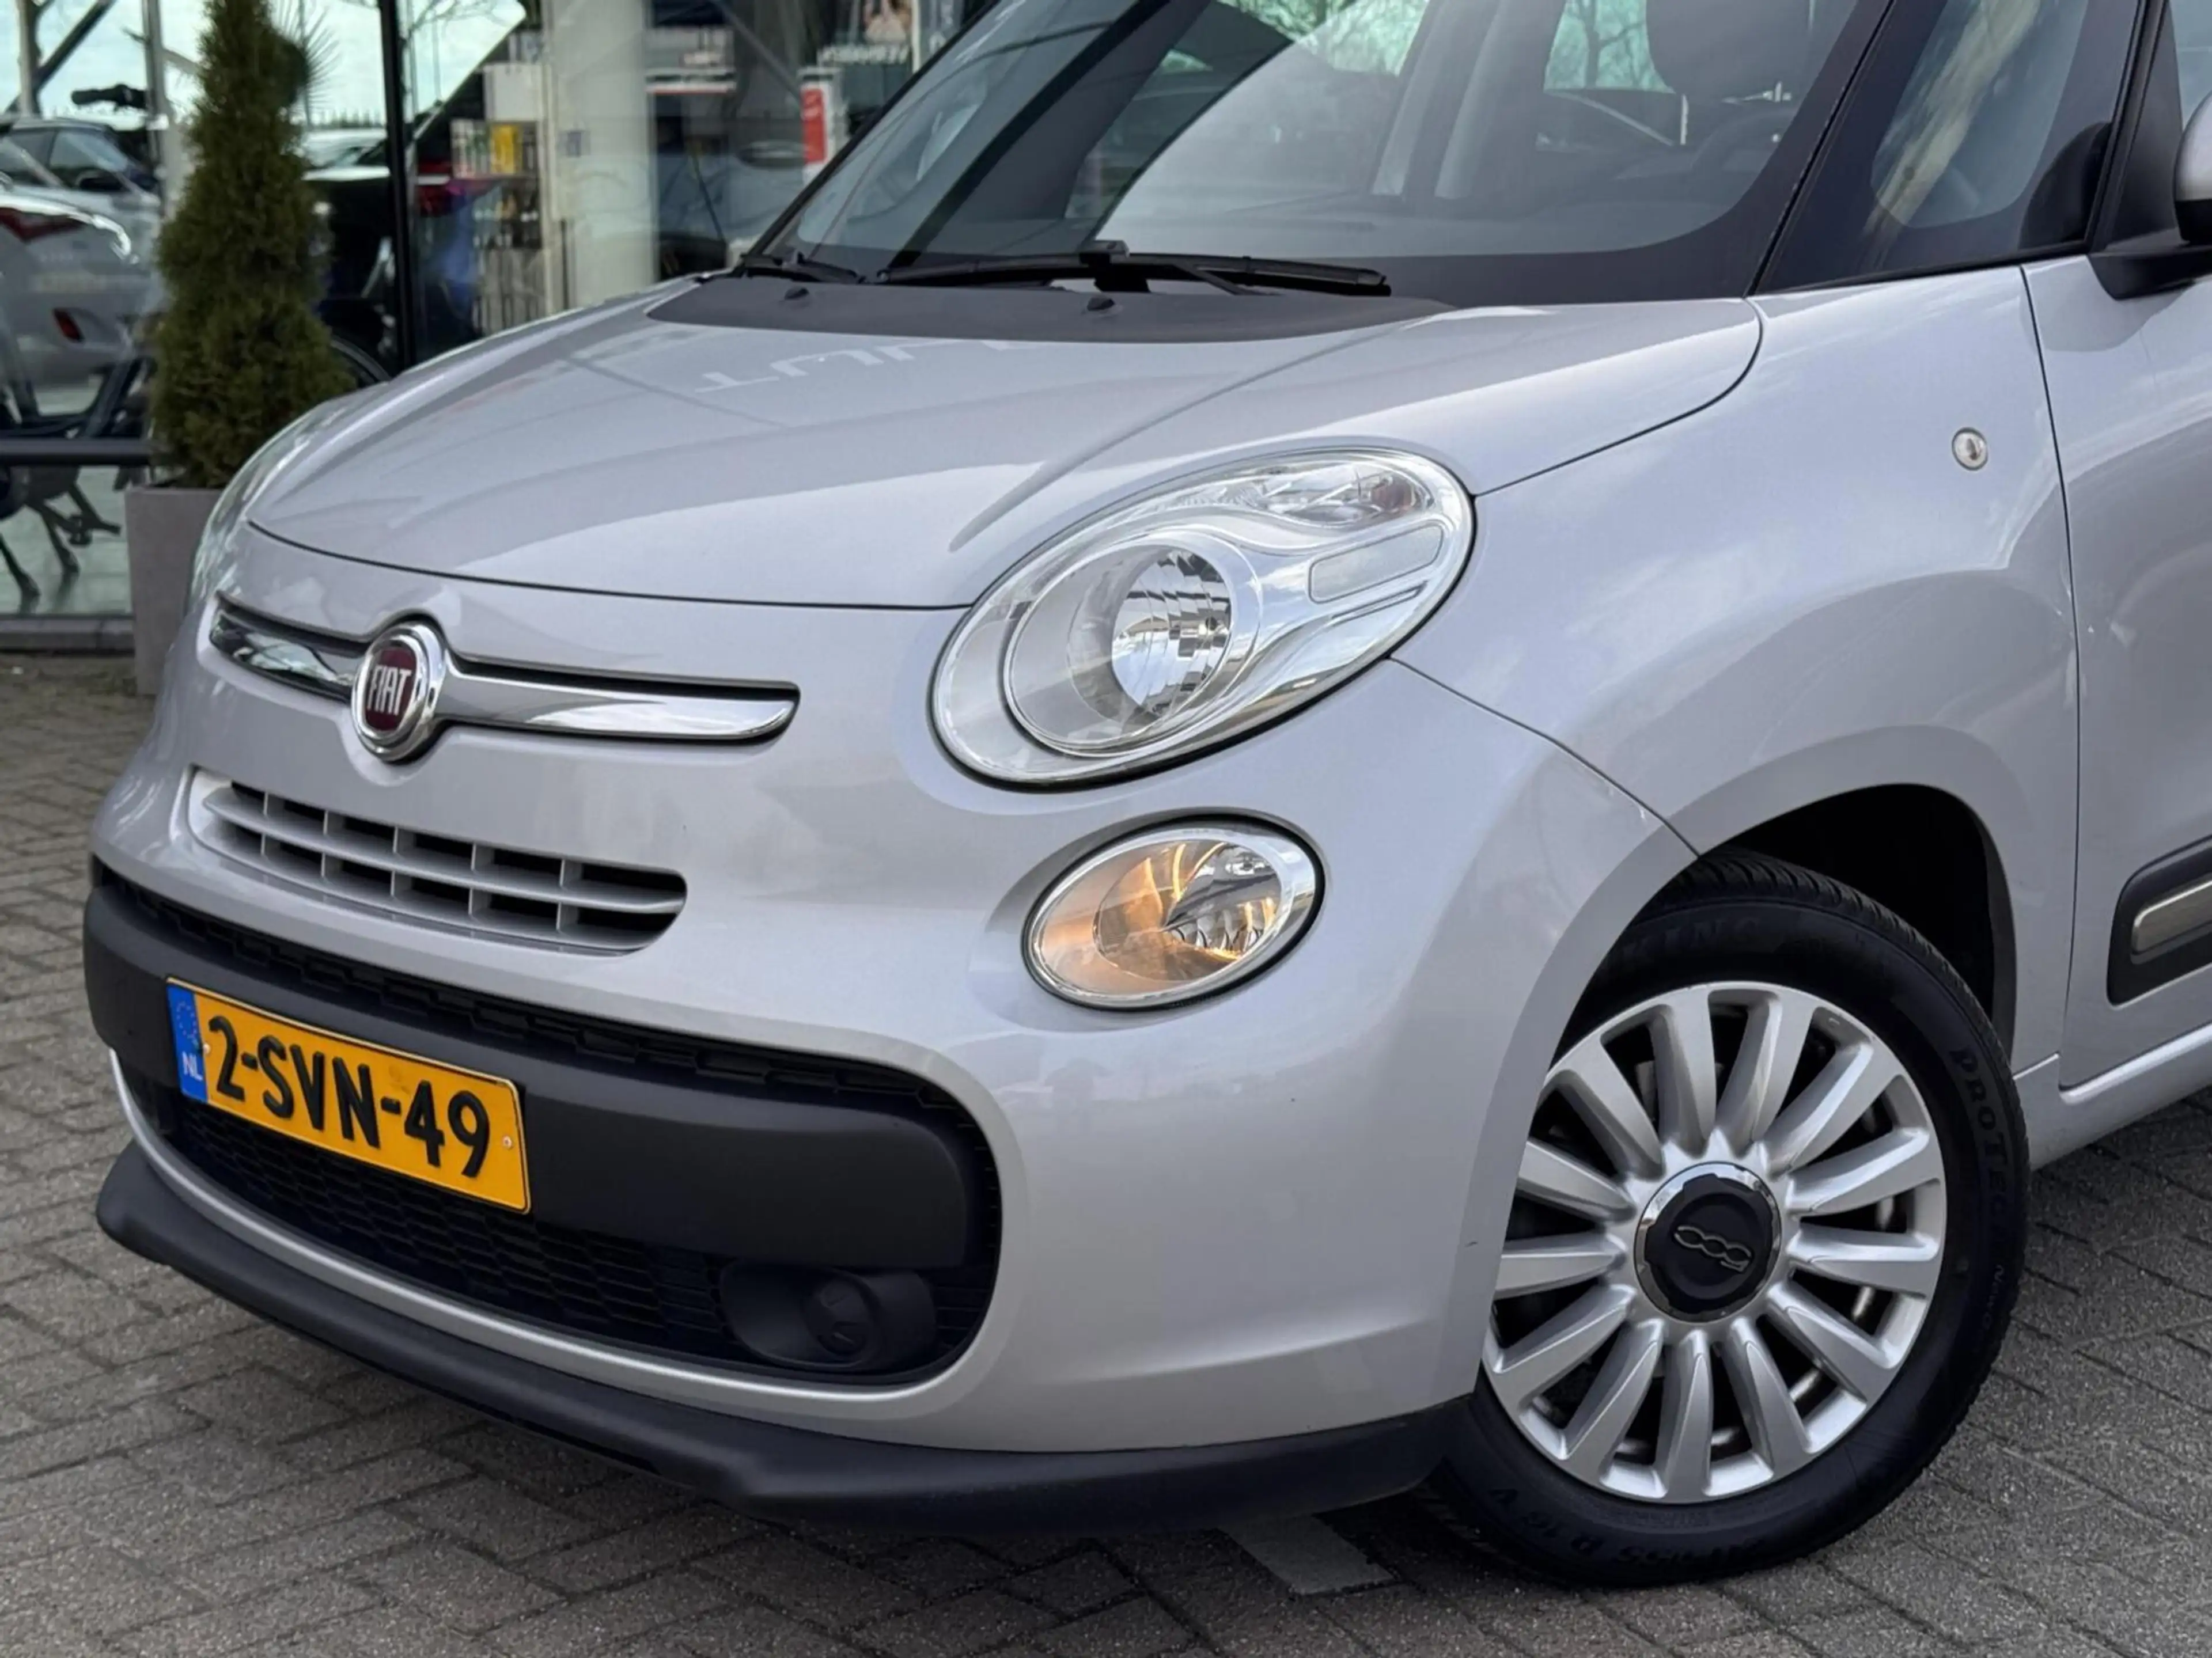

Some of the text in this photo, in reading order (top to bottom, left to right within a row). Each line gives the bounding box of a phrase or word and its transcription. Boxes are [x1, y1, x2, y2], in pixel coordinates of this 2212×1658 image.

[367, 664, 412, 716] FIAT
[181, 1051, 204, 1082] NL
[207, 1015, 490, 1178] 2-SVN-49
